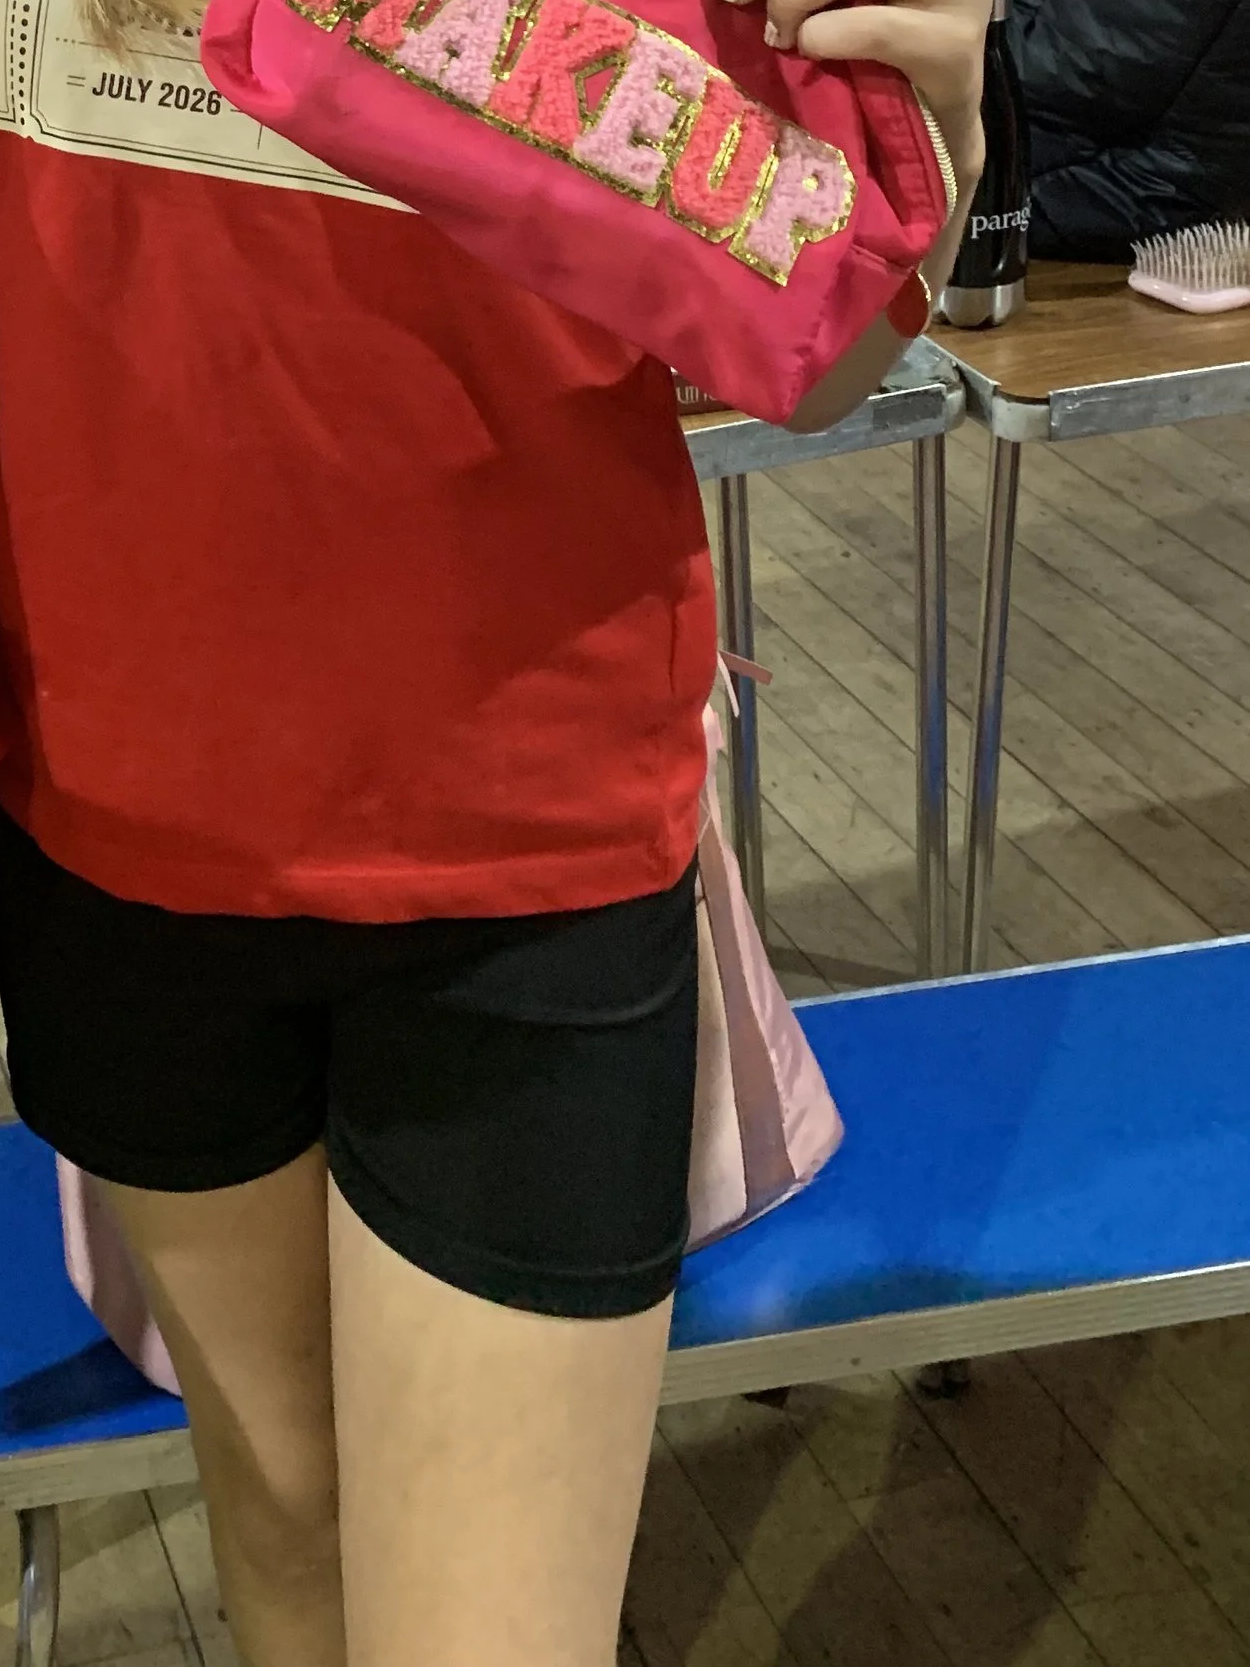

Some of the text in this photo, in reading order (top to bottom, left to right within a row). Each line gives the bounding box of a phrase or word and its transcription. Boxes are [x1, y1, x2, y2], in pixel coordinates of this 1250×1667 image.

[92, 72, 222, 115] JULY 2026
[970, 196, 1033, 240] parag
